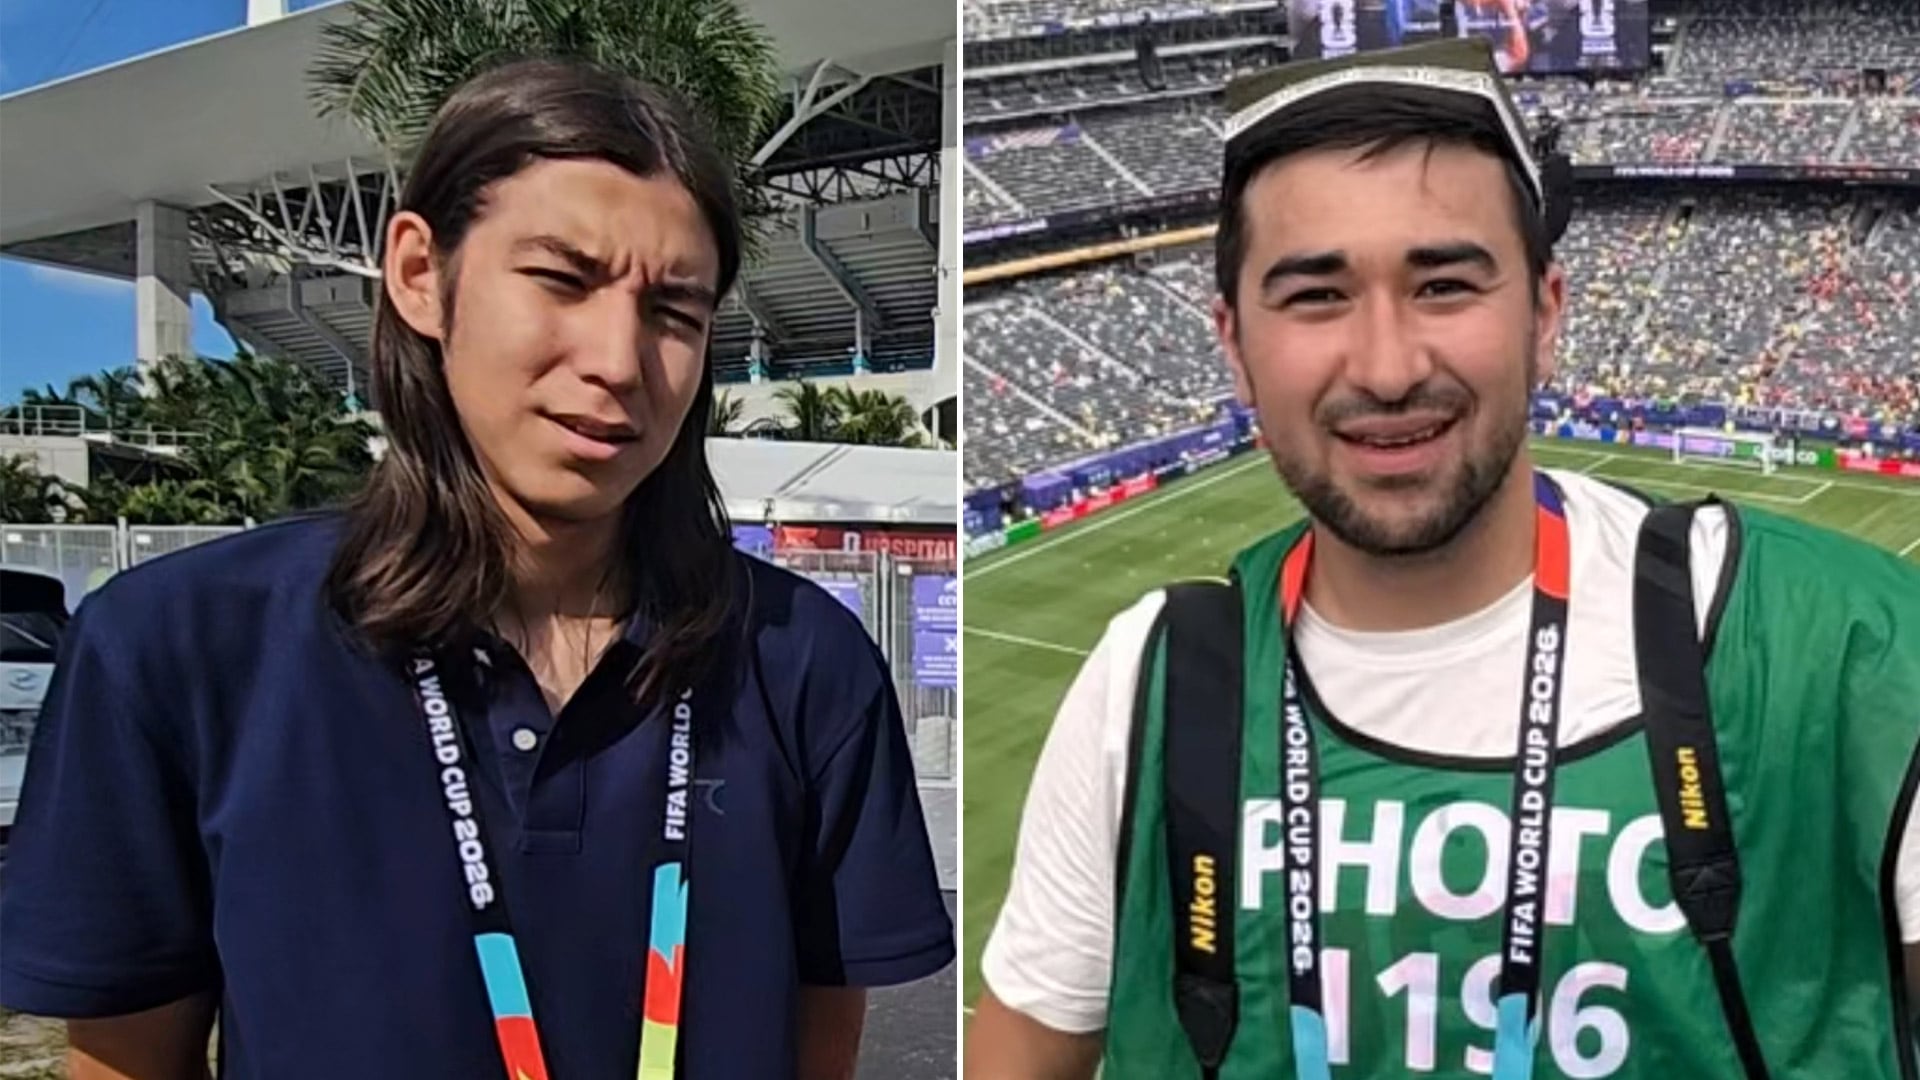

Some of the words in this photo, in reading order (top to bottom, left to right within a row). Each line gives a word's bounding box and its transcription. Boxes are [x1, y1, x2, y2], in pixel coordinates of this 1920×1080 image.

[1528, 622, 1560, 725] 2026
[419, 675, 459, 765] WORLD
[668, 703, 692, 787] WORLD
[1285, 704, 1310, 802] WORLD
[1523, 728, 1551, 786] CUP
[441, 766, 473, 817] CUP
[664, 789, 687, 840] FIFA
[1677, 747, 1709, 829] Nikon
[453, 818, 495, 910] 2026
[1239, 799, 1689, 934] PHOTO
[1288, 807, 1311, 867] CUP
[1515, 790, 1545, 897] WORLD
[1190, 855, 1216, 954] Nikon
[1290, 869, 1313, 976] 2026
[1510, 900, 1536, 964] FIFA
